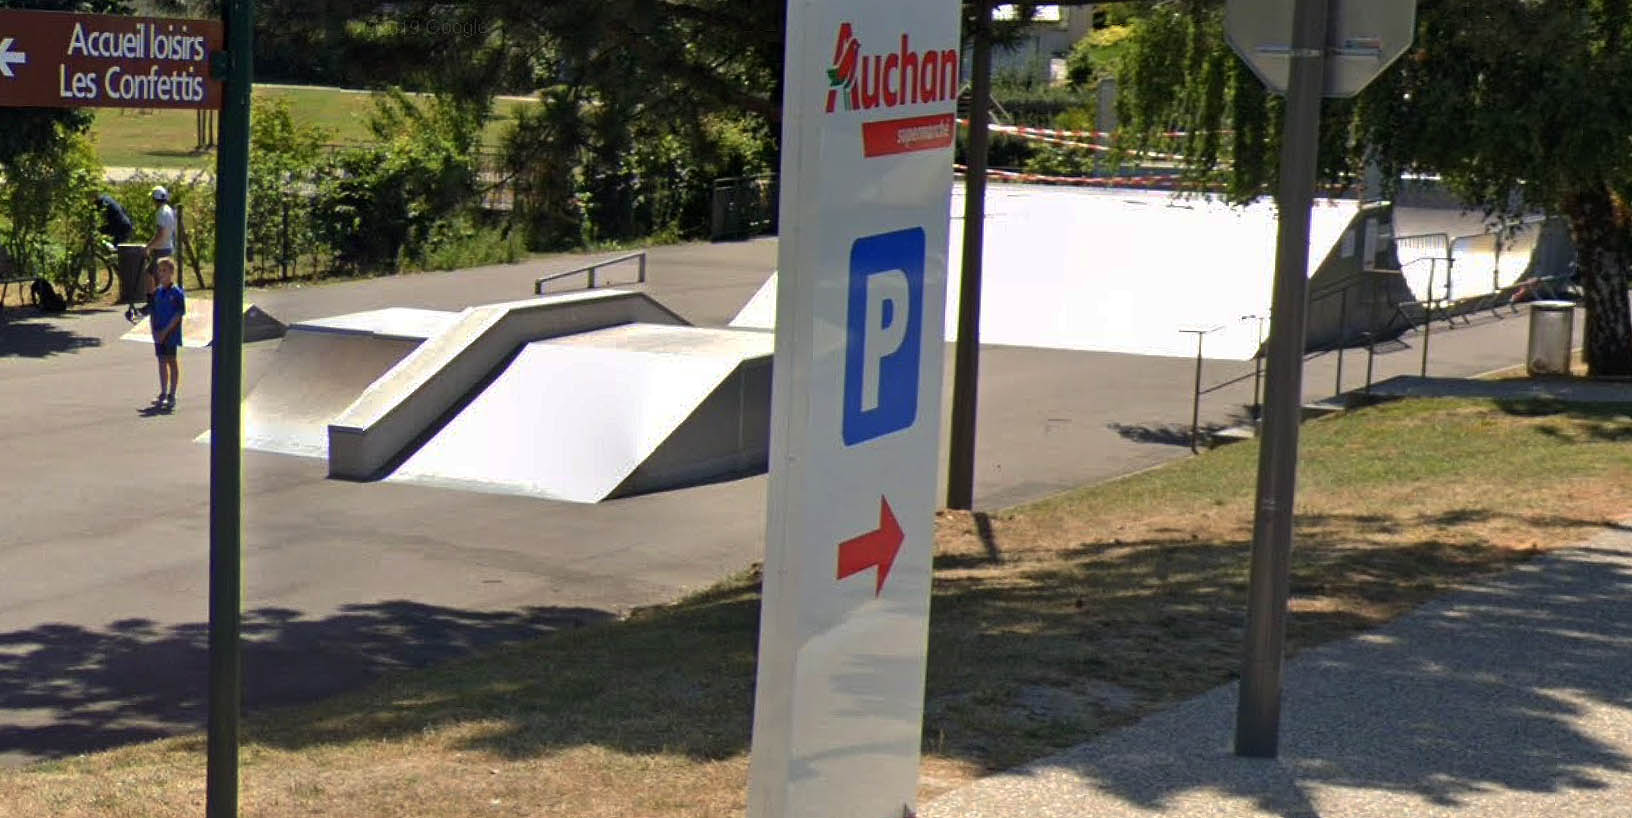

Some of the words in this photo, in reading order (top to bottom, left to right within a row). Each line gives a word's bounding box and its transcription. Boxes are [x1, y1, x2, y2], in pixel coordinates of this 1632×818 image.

[67, 22, 146, 59] Accueil
[149, 24, 205, 61] loisirs
[825, 22, 958, 113] Auchan
[59, 63, 97, 99] Les
[104, 65, 204, 102] Confettis
[861, 269, 910, 412] P
